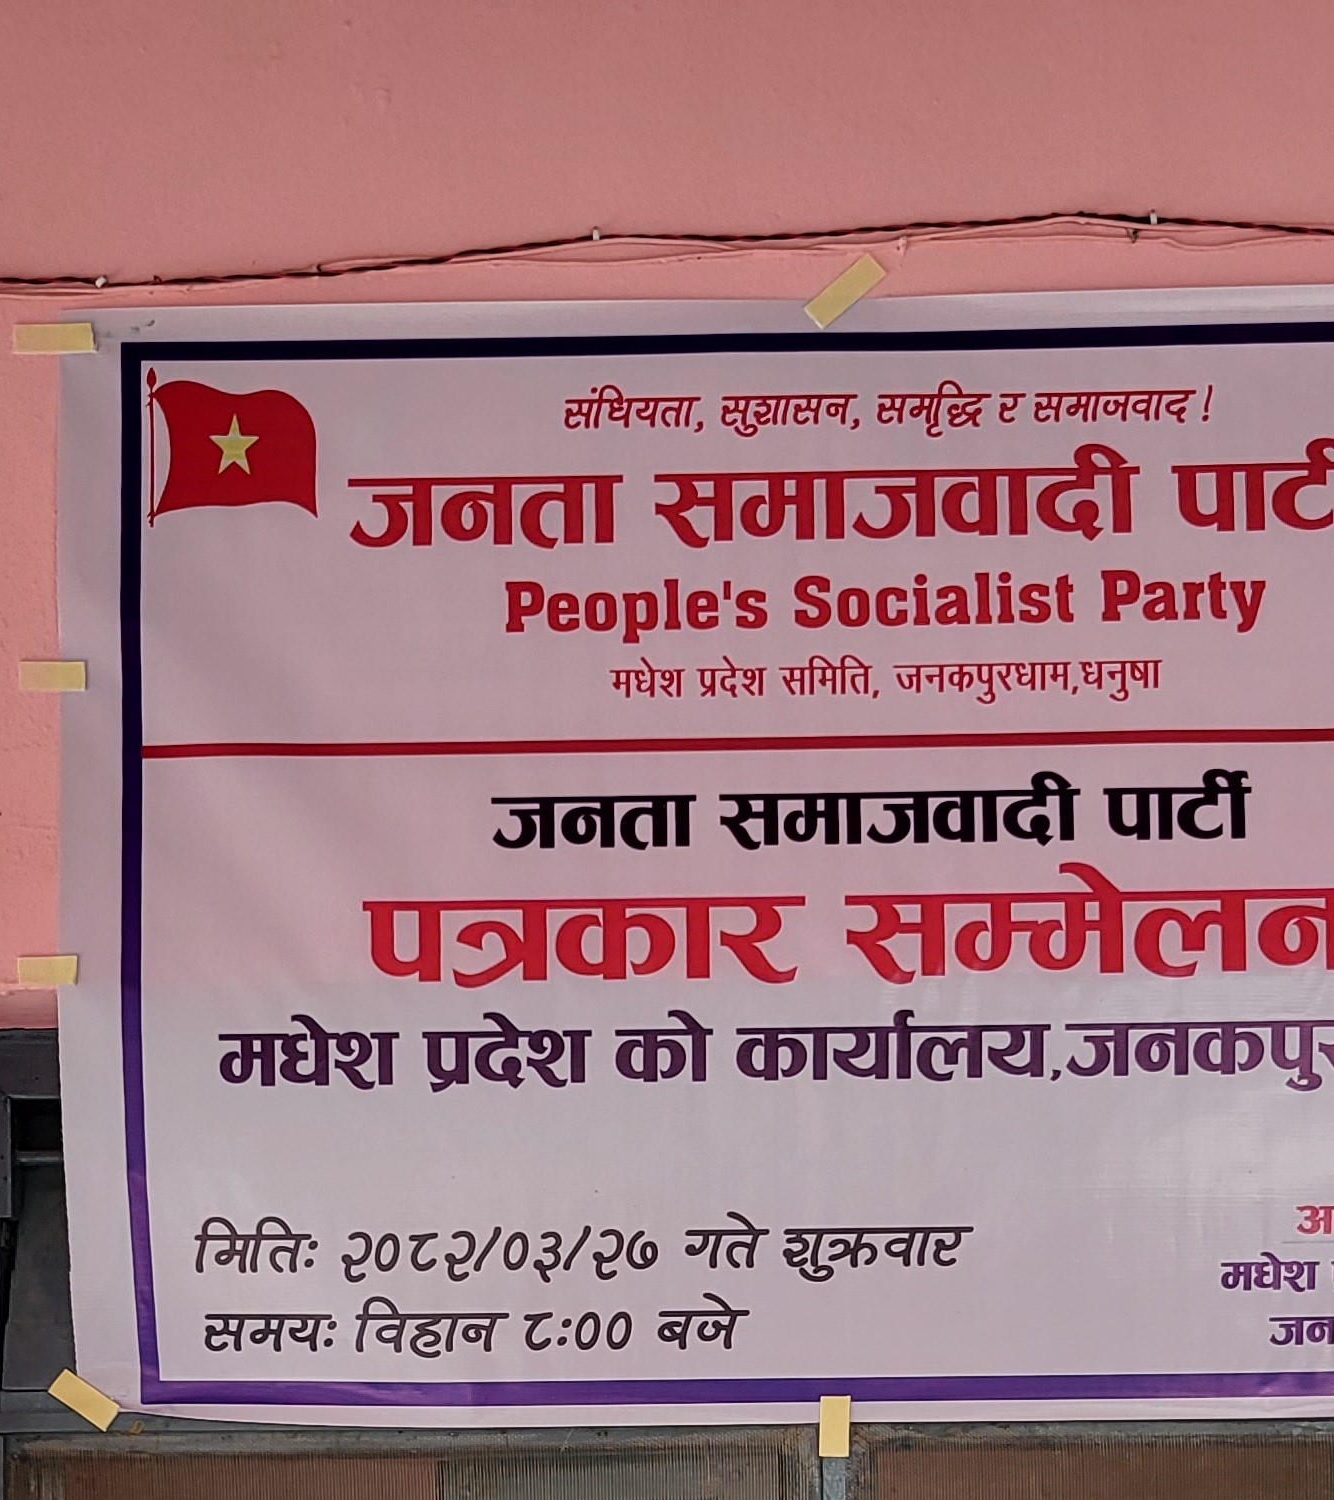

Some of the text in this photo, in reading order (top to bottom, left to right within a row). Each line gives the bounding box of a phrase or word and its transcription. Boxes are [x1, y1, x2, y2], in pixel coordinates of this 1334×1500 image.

[720, 393, 860, 438] सुशासन,
[876, 379, 991, 438] समृद्धि
[998, 392, 1027, 424] र
[347, 474, 624, 550] जनता
[653, 443, 1141, 549] समाजवादी
[504, 569, 1266, 644] People's Socialist Party
[609, 656, 686, 699] मधेश
[696, 655, 768, 698] प्रदेश
[778, 654, 880, 699] समिति,
[490, 768, 1253, 851] जनता समाजवादी पार्टी
[362, 895, 806, 989] पत्रकार
[218, 1013, 400, 1091] मधेश
[421, 1011, 593, 1093] प्रदेश
[614, 1009, 714, 1083] को
[341, 1225, 659, 1284] २०८२/०३/२७
[684, 1211, 770, 1269] गते
[782, 1226, 975, 1283] शुक्रवार
[1220, 1251, 1321, 1293] मधेश
[355, 1295, 510, 1359] विहान
[657, 1292, 751, 1351] बजे
